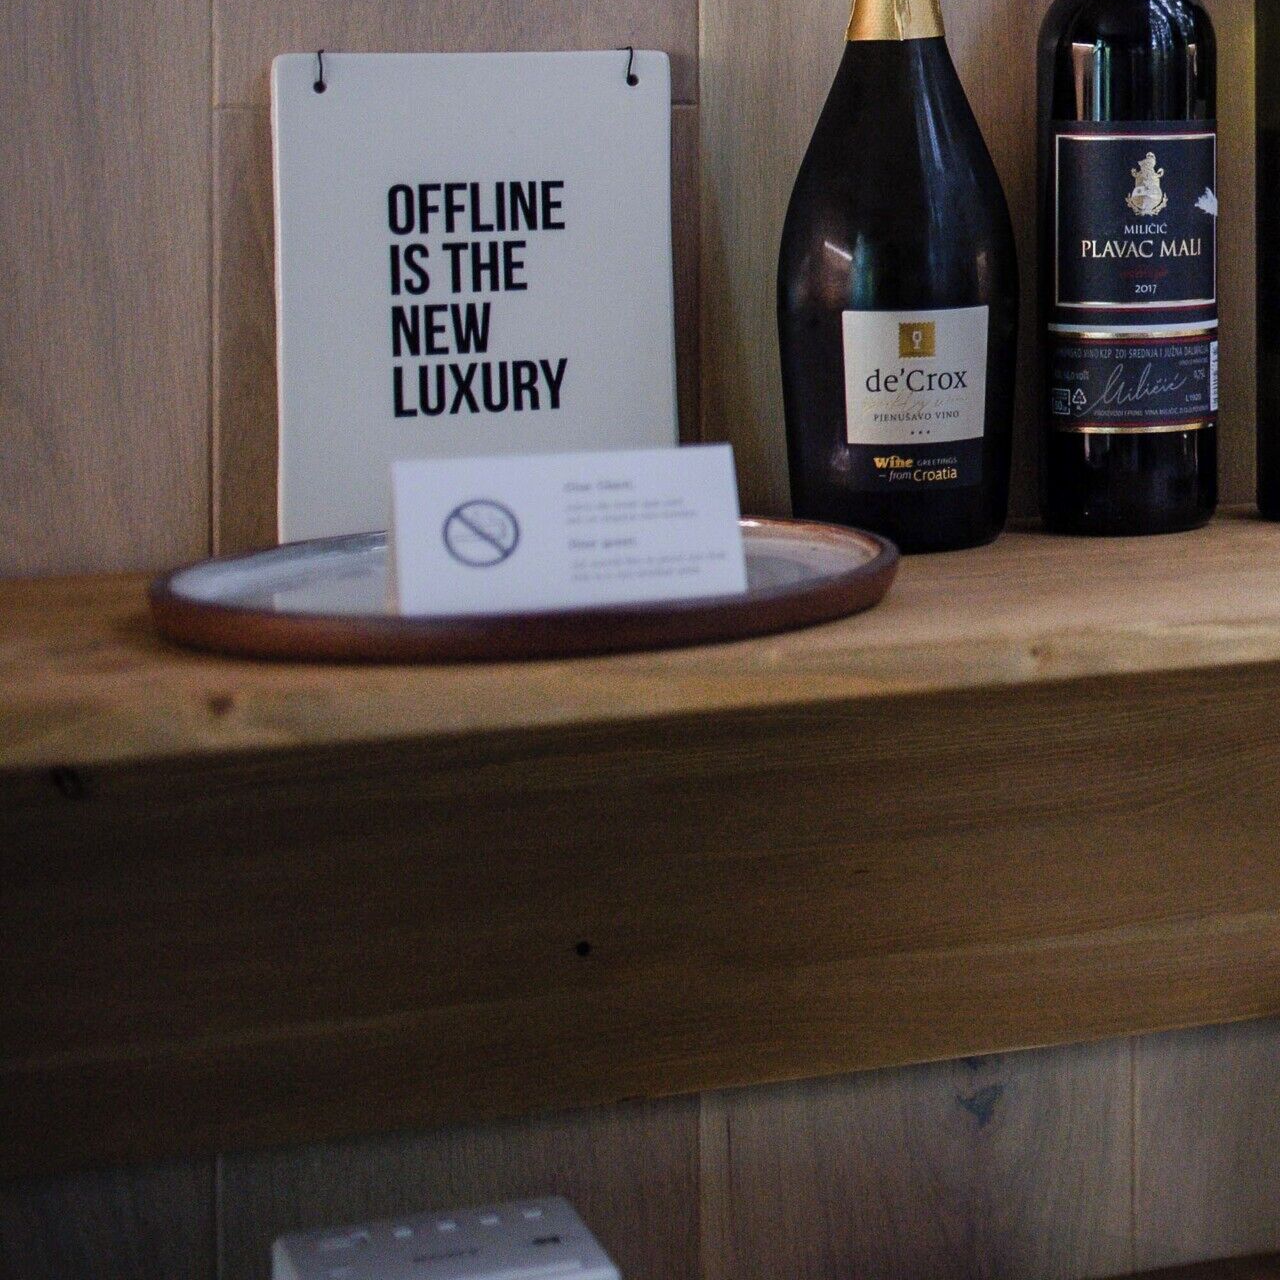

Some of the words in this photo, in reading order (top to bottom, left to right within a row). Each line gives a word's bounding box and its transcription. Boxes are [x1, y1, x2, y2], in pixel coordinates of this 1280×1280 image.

[387, 180, 566, 235] OFFLINE
[1124, 222, 1168, 234] MILIČIĆ
[1081, 239, 1154, 258] PLAVAC
[1160, 238, 1201, 257] MALI
[390, 242, 430, 296] IS
[442, 240, 528, 293] THE
[1135, 284, 1157, 294] 2017
[391, 302, 491, 357] NEW
[393, 358, 568, 418] LUXURY
[873, 411, 932, 422] PJENUŠAVO
[935, 410, 960, 419] VINO
[873, 455, 913, 469] Wine
[888, 470, 912, 482] from
[913, 467, 958, 482] Croatia
